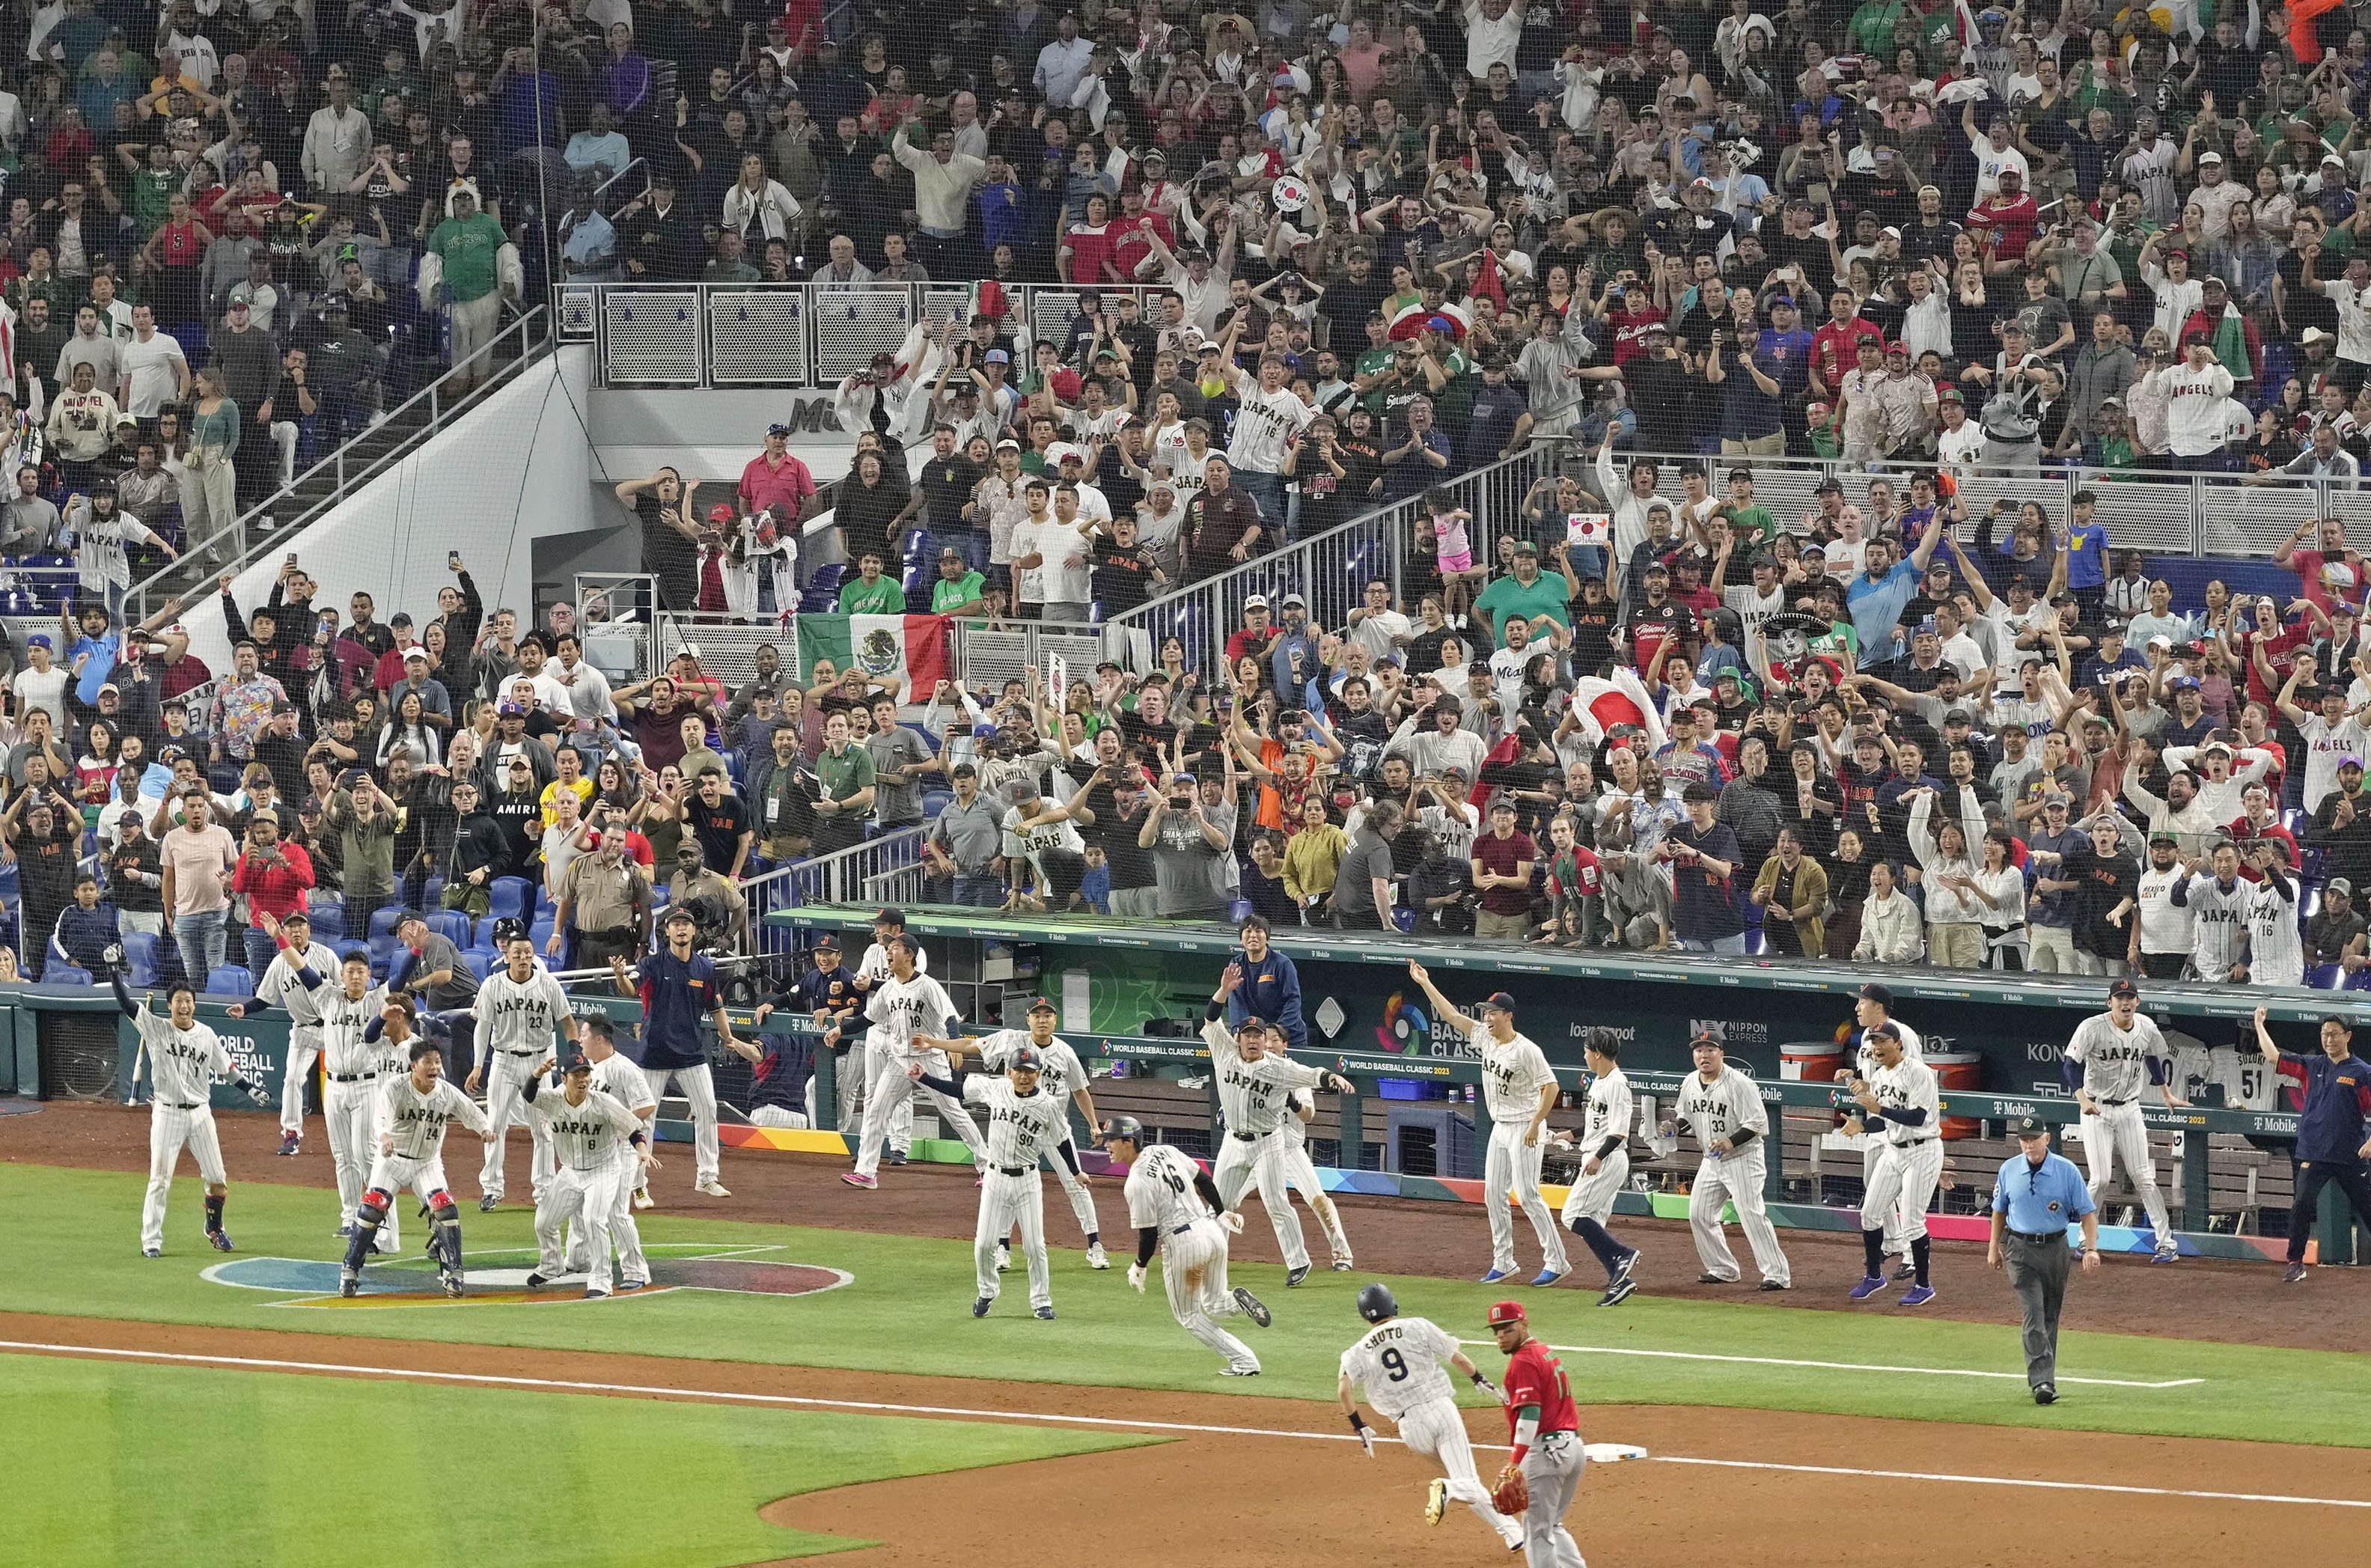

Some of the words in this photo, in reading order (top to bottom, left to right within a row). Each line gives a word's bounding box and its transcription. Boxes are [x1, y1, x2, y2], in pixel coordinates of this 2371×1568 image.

[201, 49, 211, 58] SO
[269, 242, 303, 255] THOMAS
[1078, 331, 1104, 343] GENERAS
[1616, 324, 1649, 341] Hiroshim
[1638, 336, 1646, 347] 5
[2171, 384, 2214, 400] ANGELS
[1244, 400, 1285, 427] JAPAN
[1265, 426, 1277, 438] 16
[1345, 442, 1377, 457] JAPAN
[120, 454, 137, 463] NIK
[1302, 476, 1336, 494] JAPAN
[1906, 519, 1931, 540] Me
[1108, 555, 1139, 572] JAPAN
[854, 599, 884, 611] MEXICO
[1635, 623, 1667, 636] Calient
[2270, 653, 2292, 666] GEL
[1497, 666, 1525, 680] Mia
[2027, 719, 2053, 739] ONS
[1851, 787, 1875, 801] APA
[497, 805, 537, 815] AMIRI
[710, 817, 734, 830] PAN
[1162, 829, 1200, 840] CHAMPIONS
[1441, 832, 1462, 846] PAN
[1024, 832, 1061, 852] APAN
[2096, 868, 2117, 885] PAN
[2203, 909, 2239, 923] JAPA
[2248, 907, 2278, 922] APAN
[2262, 924, 2273, 937] 16
[281, 969, 328, 993] JAN
[495, 998, 549, 1015] JAPAN
[581, 1003, 607, 1016] Mobile
[889, 997, 924, 1013] APAN
[331, 1015, 369, 1027] JAPA
[528, 1016, 543, 1028] 23
[736, 1013, 751, 1025] 2023
[910, 1016, 921, 1028] 18
[1729, 1022, 1768, 1035] NIPPON
[218, 1036, 254, 1053] ORLD
[1729, 1034, 1768, 1046] EXPRESS
[1113, 1044, 1135, 1053] WORLD
[1136, 1046, 1168, 1055] BASEBALL
[1168, 1048, 1194, 1057] CLASSIC
[1195, 1049, 1210, 1058] 2023
[1431, 1041, 1483, 1058] CLASS
[2027, 1043, 2063, 1063] KON
[234, 1053, 275, 1071] EBALL
[377, 1060, 412, 1074] JAPA
[1349, 1062, 1372, 1072] WORLD
[1373, 1064, 1405, 1074] BASEBALL
[1406, 1066, 1433, 1076] CLASSIC
[1434, 1067, 1450, 1076] 2023
[1483, 1058, 1514, 1083] APAN
[1224, 1070, 1273, 1096] JAPAN
[1653, 1082, 1679, 1093] CLASSIC
[2242, 1070, 2262, 1100] 51
[1760, 1086, 1782, 1101] obile
[1253, 1097, 1265, 1110] 10
[1690, 1099, 1727, 1117] APAN
[2004, 1102, 2036, 1116] Mobile
[398, 1109, 447, 1127] JAPAN
[991, 1108, 1042, 1135] JAPAN
[1594, 1117, 1600, 1129] 5
[2158, 1114, 2188, 1124] CLASSIC
[2188, 1116, 2206, 1125] 2023
[2265, 1117, 2298, 1133] Mobile
[552, 1122, 604, 1135] JAPAN
[1712, 1120, 1725, 1134] 33
[426, 1128, 439, 1141] 24
[1019, 1133, 1034, 1147] 90
[610, 1140, 619, 1150] 8
[1162, 1164, 1186, 1199] 16
[1365, 1327, 1403, 1349] SHUTO
[1381, 1347, 1409, 1382] 9
